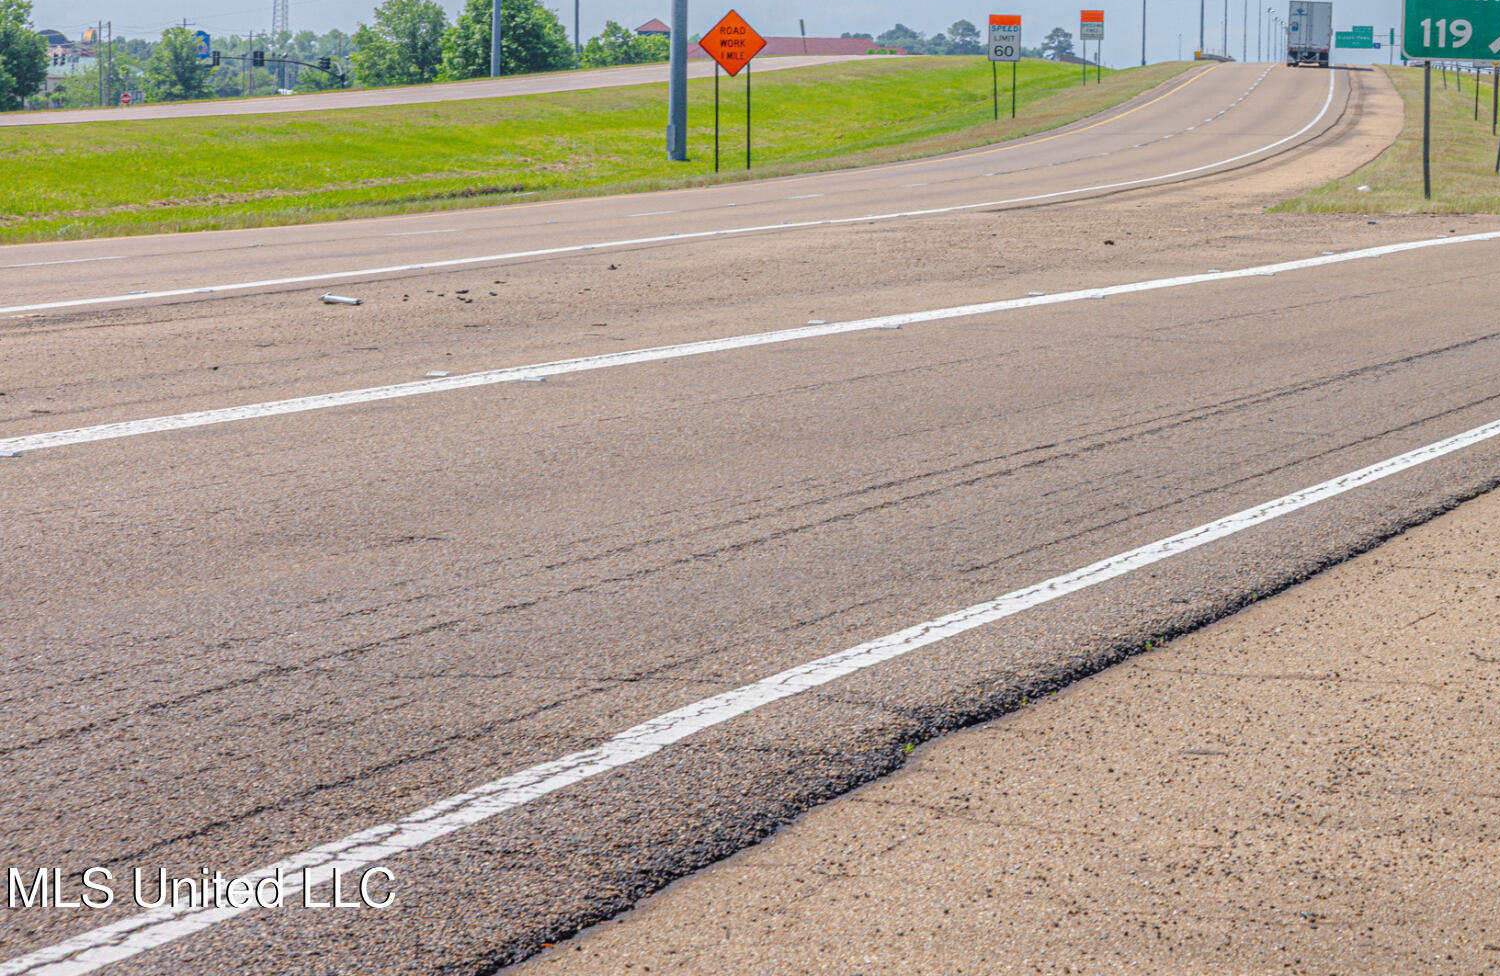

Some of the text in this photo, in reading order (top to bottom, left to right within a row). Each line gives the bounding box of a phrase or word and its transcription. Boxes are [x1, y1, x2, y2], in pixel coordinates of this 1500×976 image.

[720, 26, 746, 35] ROAD
[991, 25, 1019, 33] SPEED
[1420, 18, 1473, 48] 119
[720, 39, 746, 48] WORK
[727, 51, 744, 60] MILE
[994, 45, 1014, 57] 60
